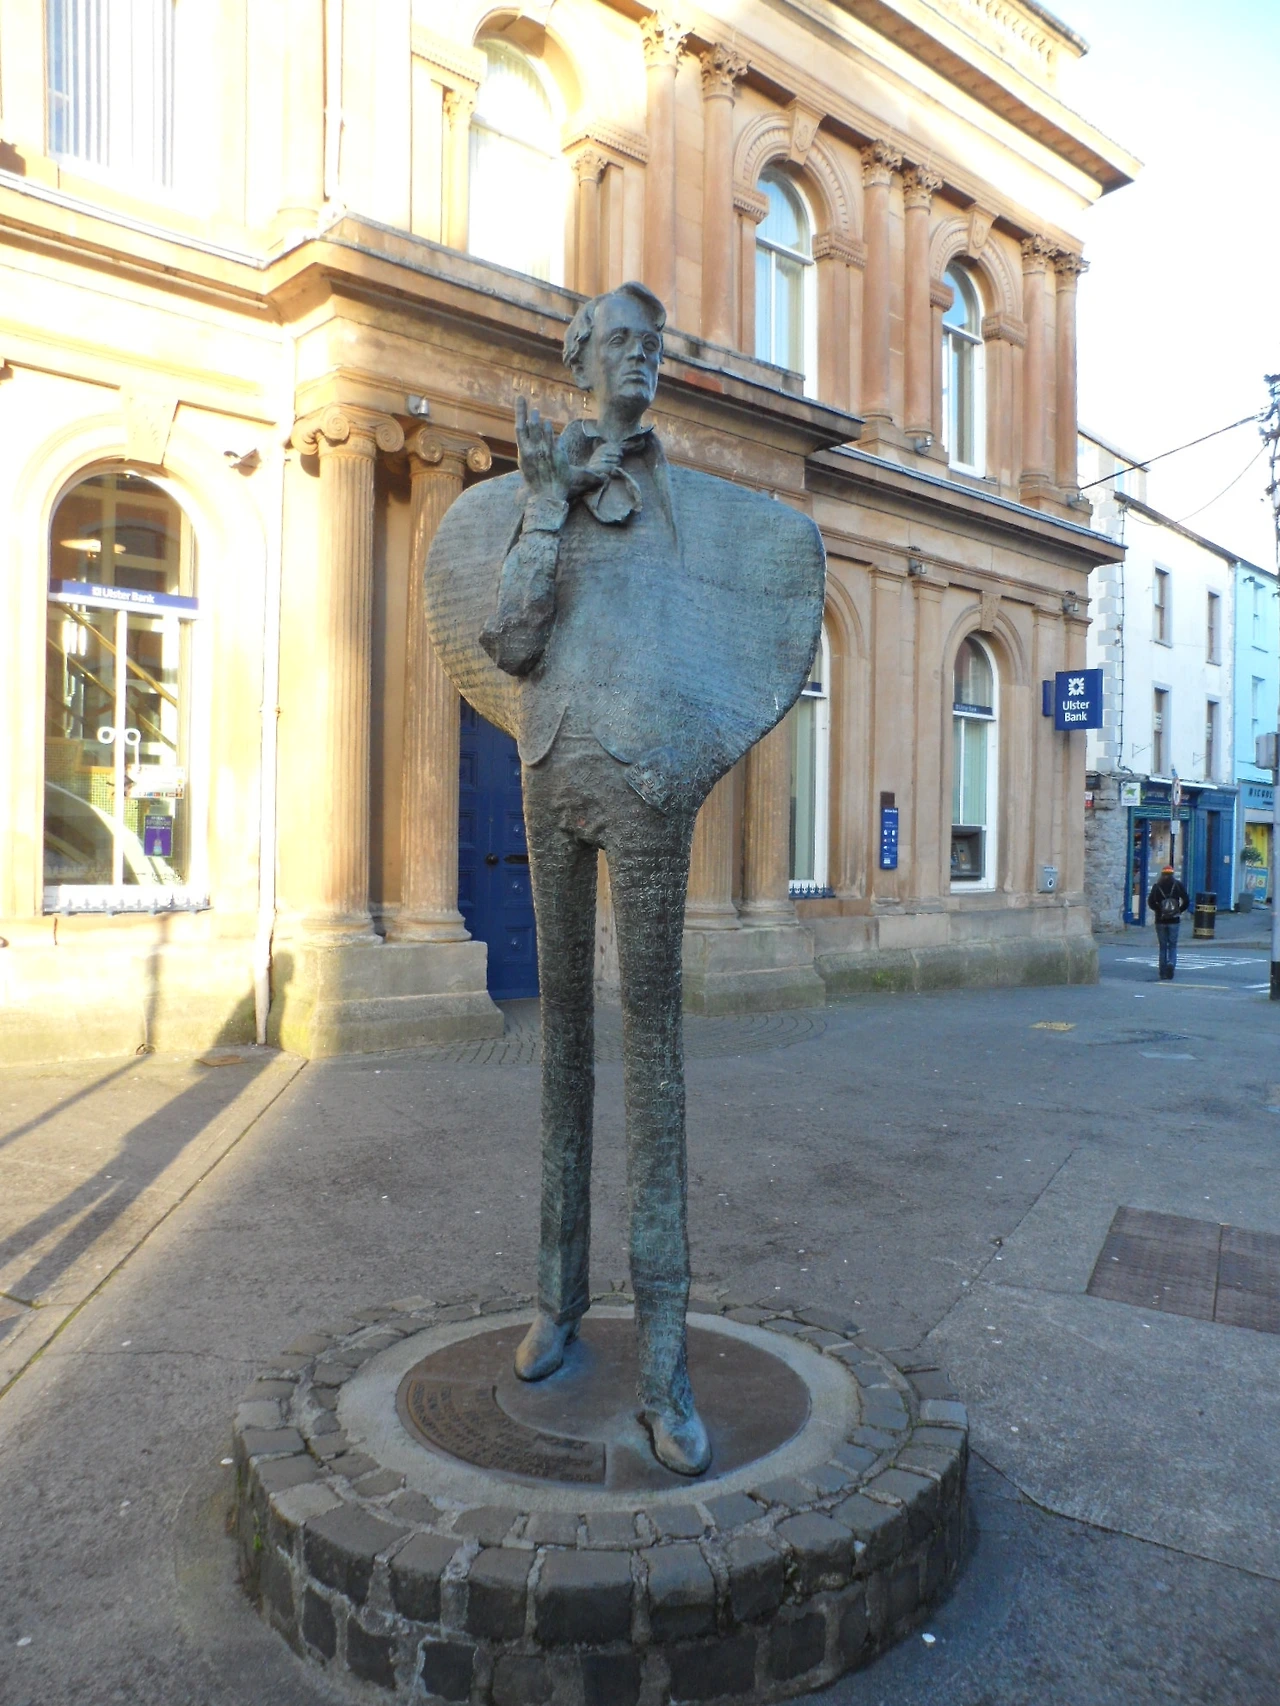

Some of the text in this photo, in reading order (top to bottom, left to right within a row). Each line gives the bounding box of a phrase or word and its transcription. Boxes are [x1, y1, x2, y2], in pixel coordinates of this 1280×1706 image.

[102, 587, 155, 604] Ulster Bank
[1062, 700, 1090, 711] Ulster
[1064, 711, 1088, 722] Bank
